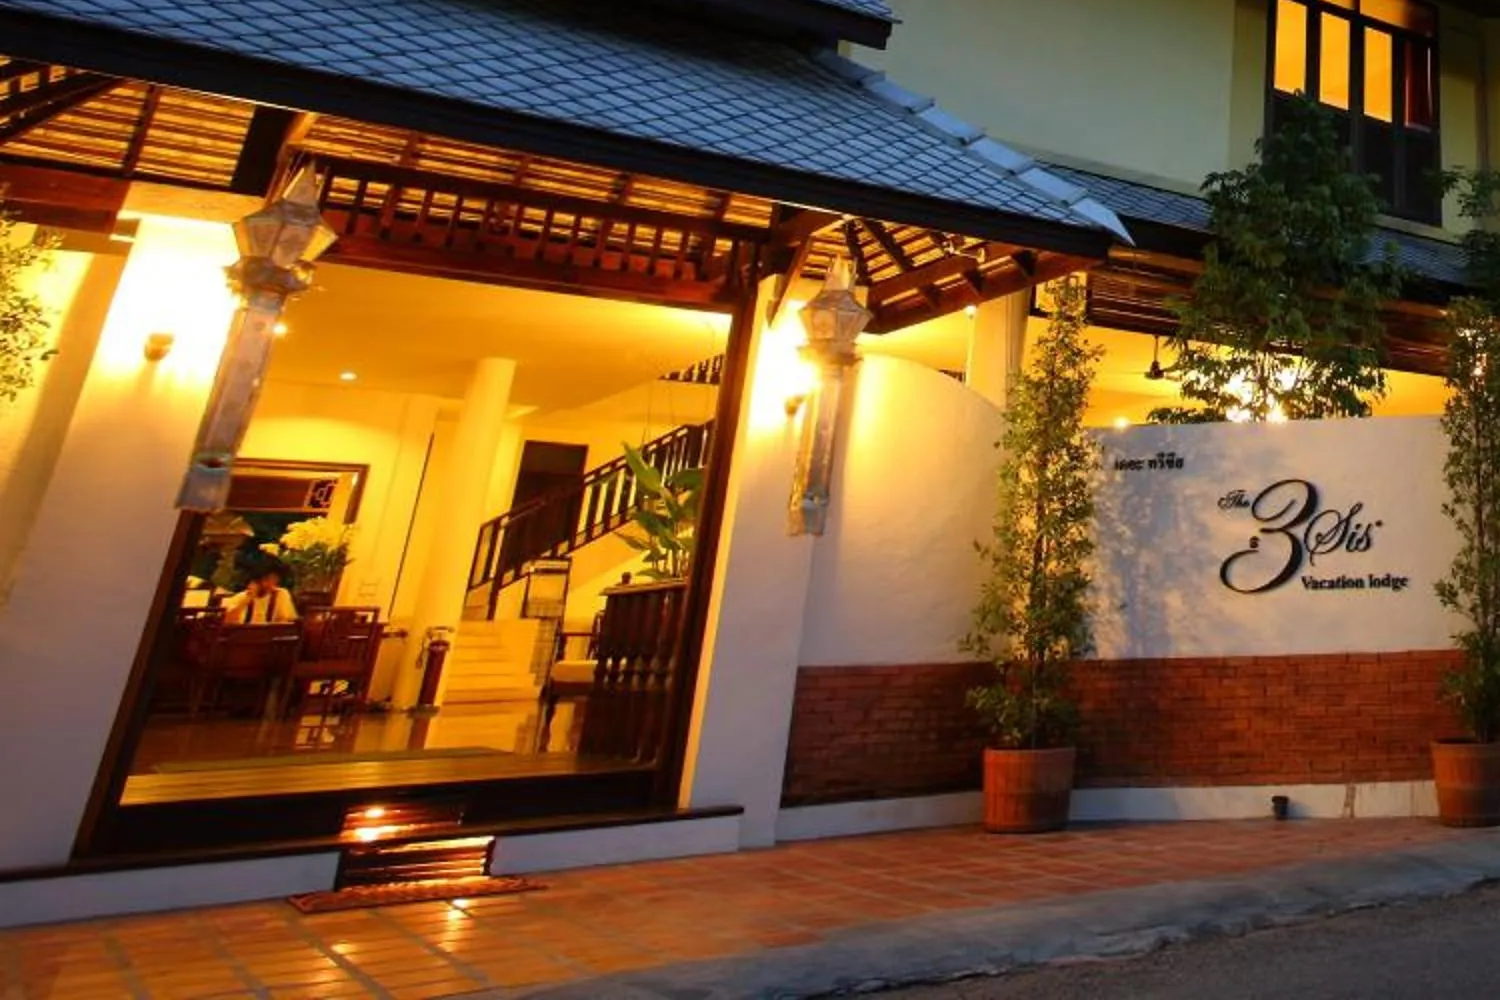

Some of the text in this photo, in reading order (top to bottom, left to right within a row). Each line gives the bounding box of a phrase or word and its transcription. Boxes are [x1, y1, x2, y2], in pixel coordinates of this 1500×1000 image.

[1217, 489, 1250, 510] The
[1219, 478, 1319, 595] 3
[1300, 573, 1409, 593] Vacation lodge
